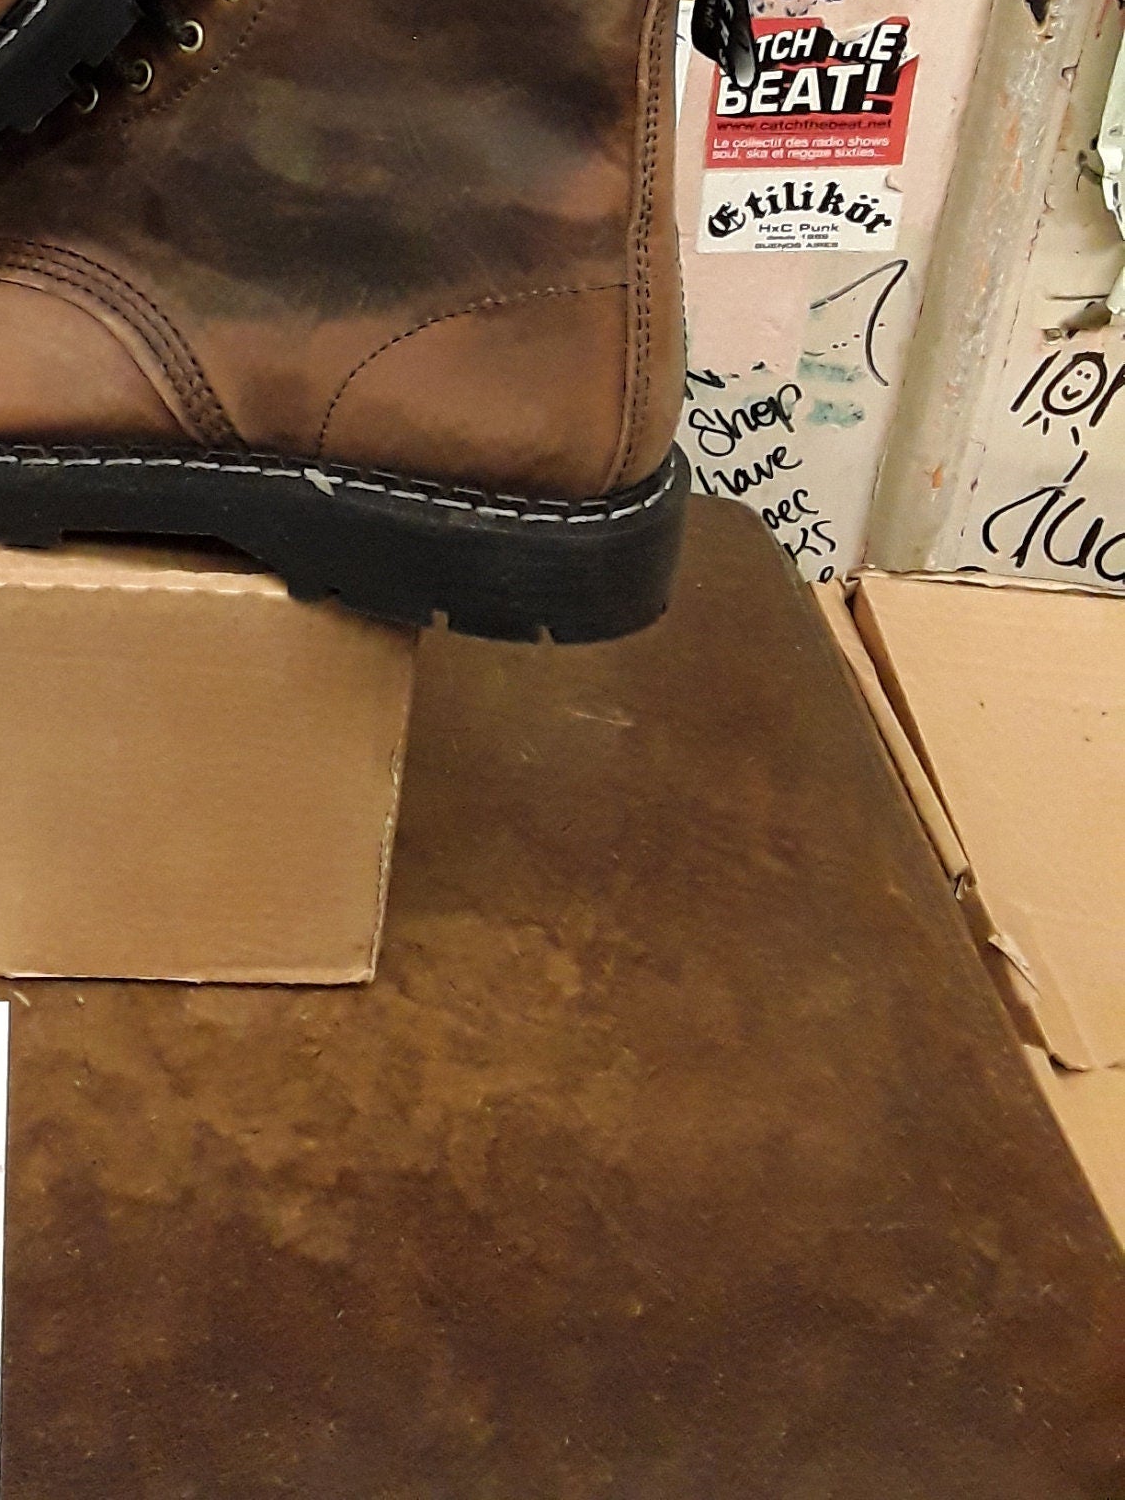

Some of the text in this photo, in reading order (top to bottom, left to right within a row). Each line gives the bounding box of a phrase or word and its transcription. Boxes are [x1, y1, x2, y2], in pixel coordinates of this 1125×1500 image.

[756, 26, 817, 62] TCH
[716, 62, 884, 115] BEAT!
[716, 118, 892, 133] www.catchthebeat.net
[746, 148, 769, 160] ska
[771, 149, 784, 159] et
[787, 149, 832, 161] reggae
[785, 137, 809, 148] des
[813, 136, 843, 148] radio
[847, 136, 890, 148] shows
[708, 181, 892, 238] Etilikör
[758, 222, 840, 233] HxC Punk
[754, 241, 839, 250] BUENOS AIRES
[689, 384, 802, 457] Shop
[695, 445, 804, 497] have
